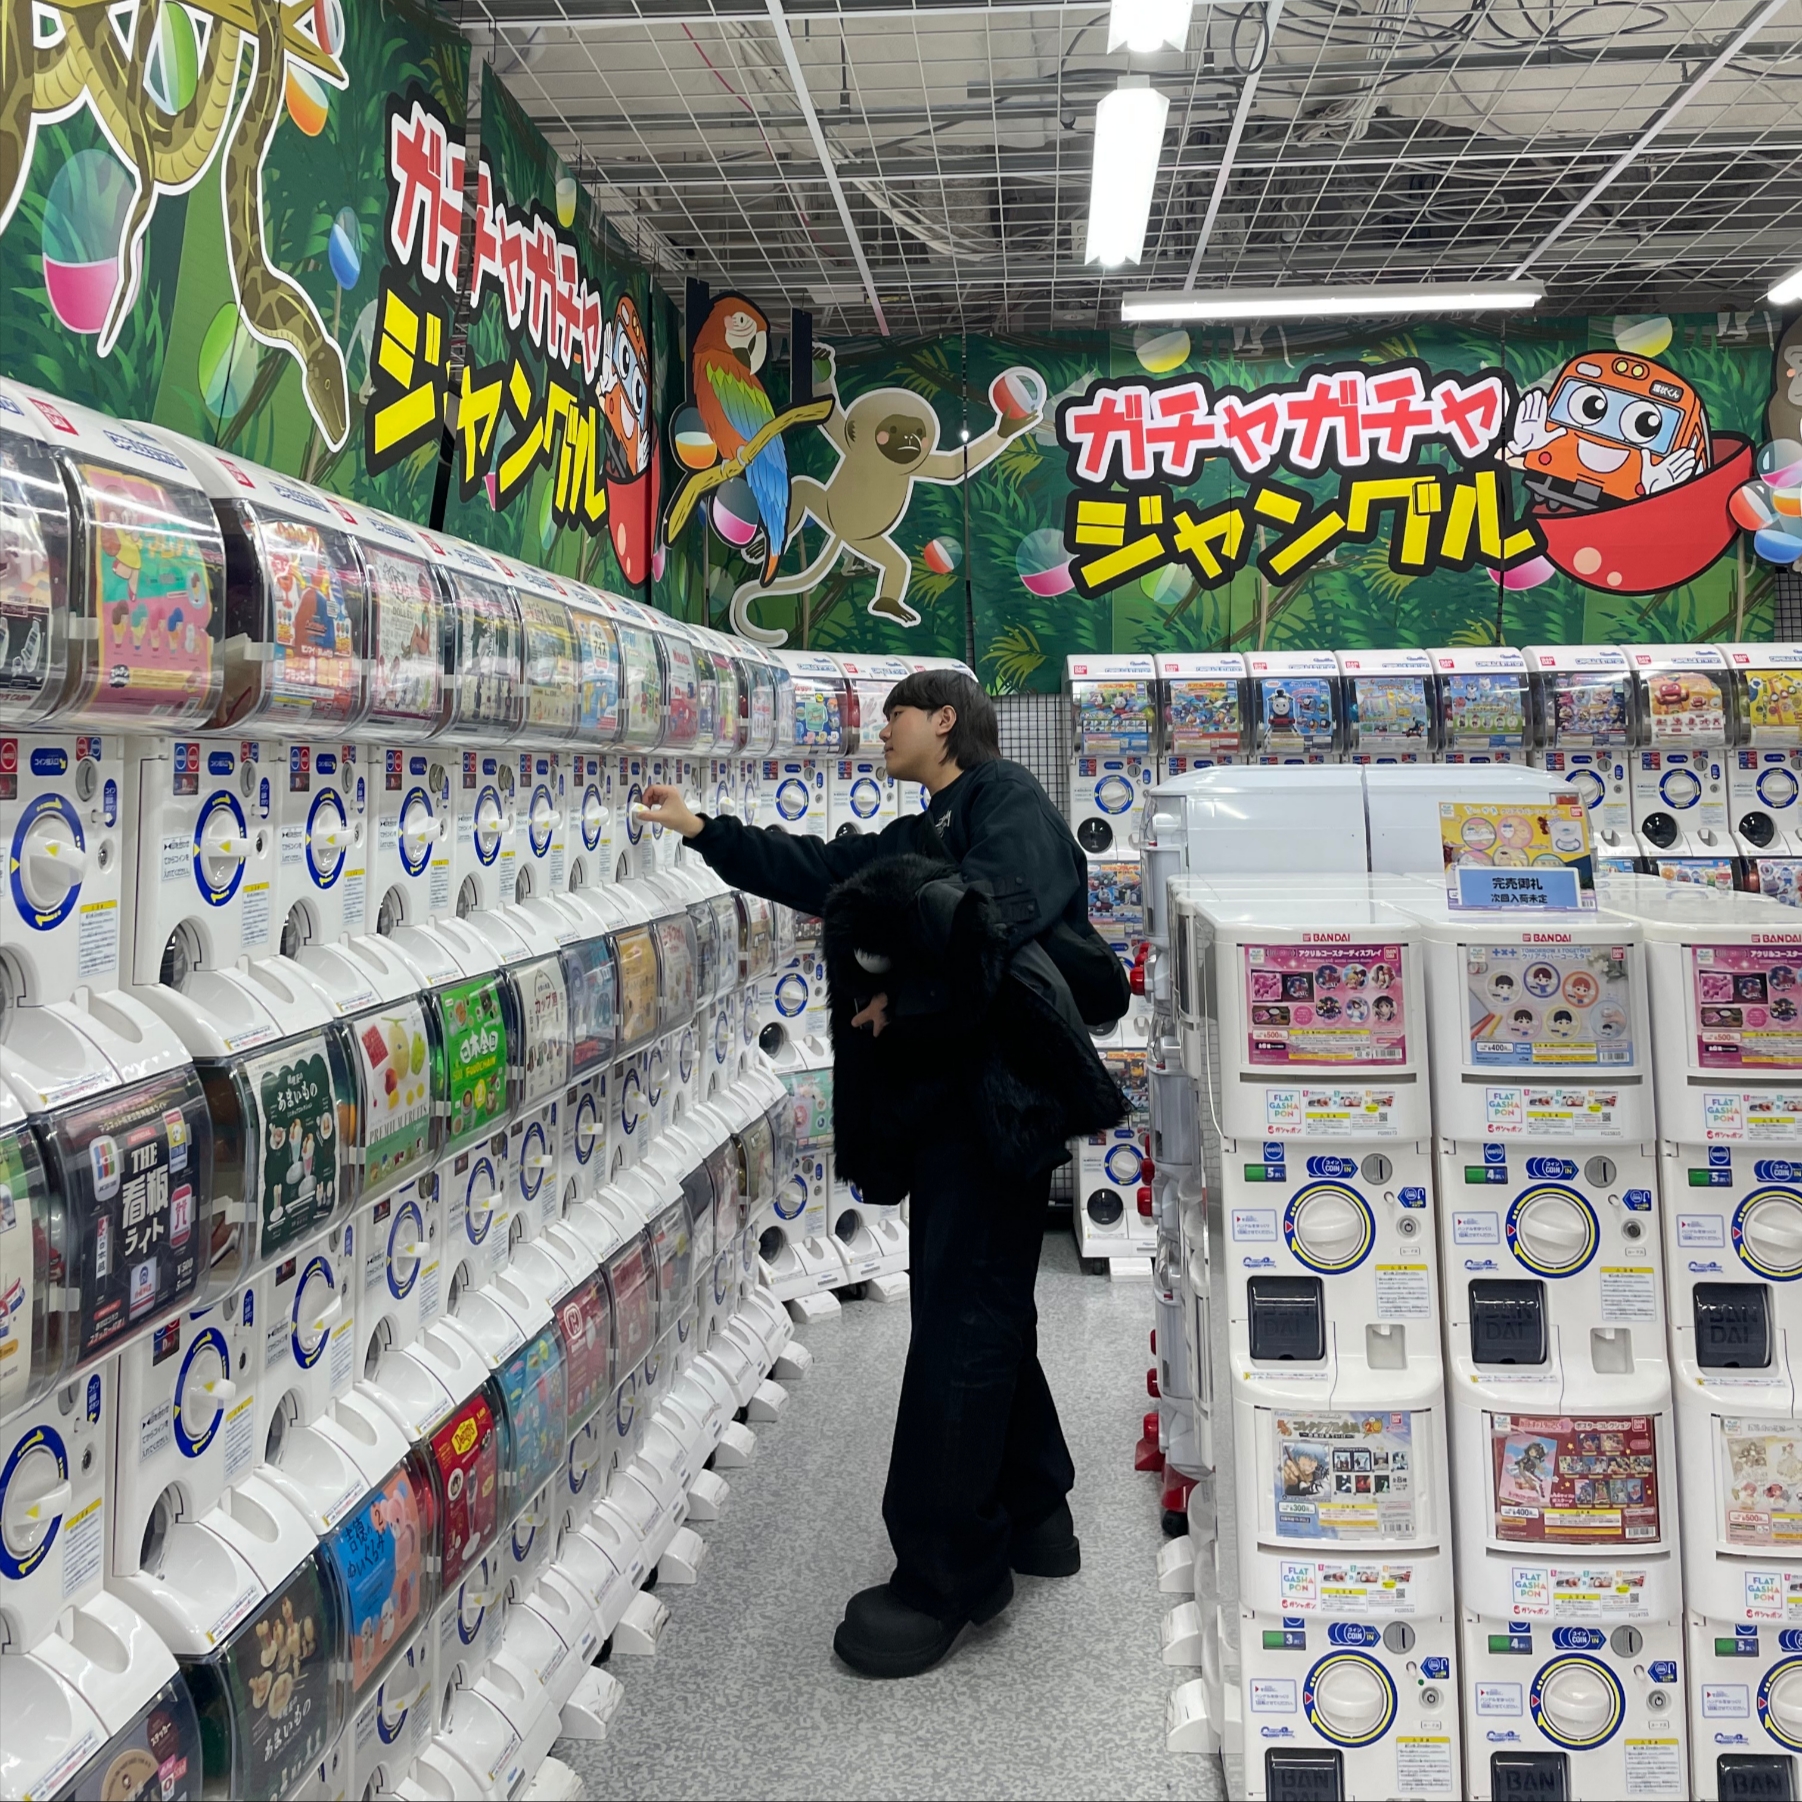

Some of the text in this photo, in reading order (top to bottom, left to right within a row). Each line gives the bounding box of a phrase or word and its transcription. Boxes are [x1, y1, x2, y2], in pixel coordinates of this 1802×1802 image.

[375, 289, 606, 521] ジャングル
[1067, 369, 1501, 481] ガチャガチャ
[1075, 471, 1536, 588] ジャングル
[1492, 878, 1543, 890] 完売御礼
[1490, 894, 1548, 904] 次回入荷未定
[1313, 934, 1350, 942] BANDAI
[1533, 934, 1572, 942] BANDAI
[1762, 934, 1802, 943] BANDAI
[1298, 950, 1382, 958] アクリルコースターディスプレイ
[277, 1080, 318, 1112] あまいもの
[1269, 1102, 1299, 1110] GASHA
[370, 1102, 428, 1146] PREMIUM FRUITS
[1495, 1124, 1522, 1133] ガシャポン
[1275, 1126, 1302, 1134] ガシャポン
[131, 1142, 158, 1174] THE
[122, 1164, 168, 1230] 看板
[124, 1217, 164, 1256] ライト
[1711, 1326, 1749, 1344] DAI
[374, 1508, 384, 1526] 2
[1288, 1567, 1309, 1575] FLAT
[1284, 1576, 1314, 1584] GASHA
[1753, 1577, 1774, 1585] FLAT
[1515, 1581, 1546, 1590] GASHA
[1748, 1585, 1780, 1594] GASHA
[1521, 1590, 1541, 1598] PON
[1754, 1594, 1774, 1602] PON
[1289, 1601, 1316, 1610] ガシャポン
[1522, 1606, 1549, 1614] ガシャポン
[264, 1698, 312, 1762] あまいもの
[1281, 1770, 1330, 1788] BAN
[1506, 1771, 1555, 1791] BAN
[1732, 1772, 1782, 1794] BAN
